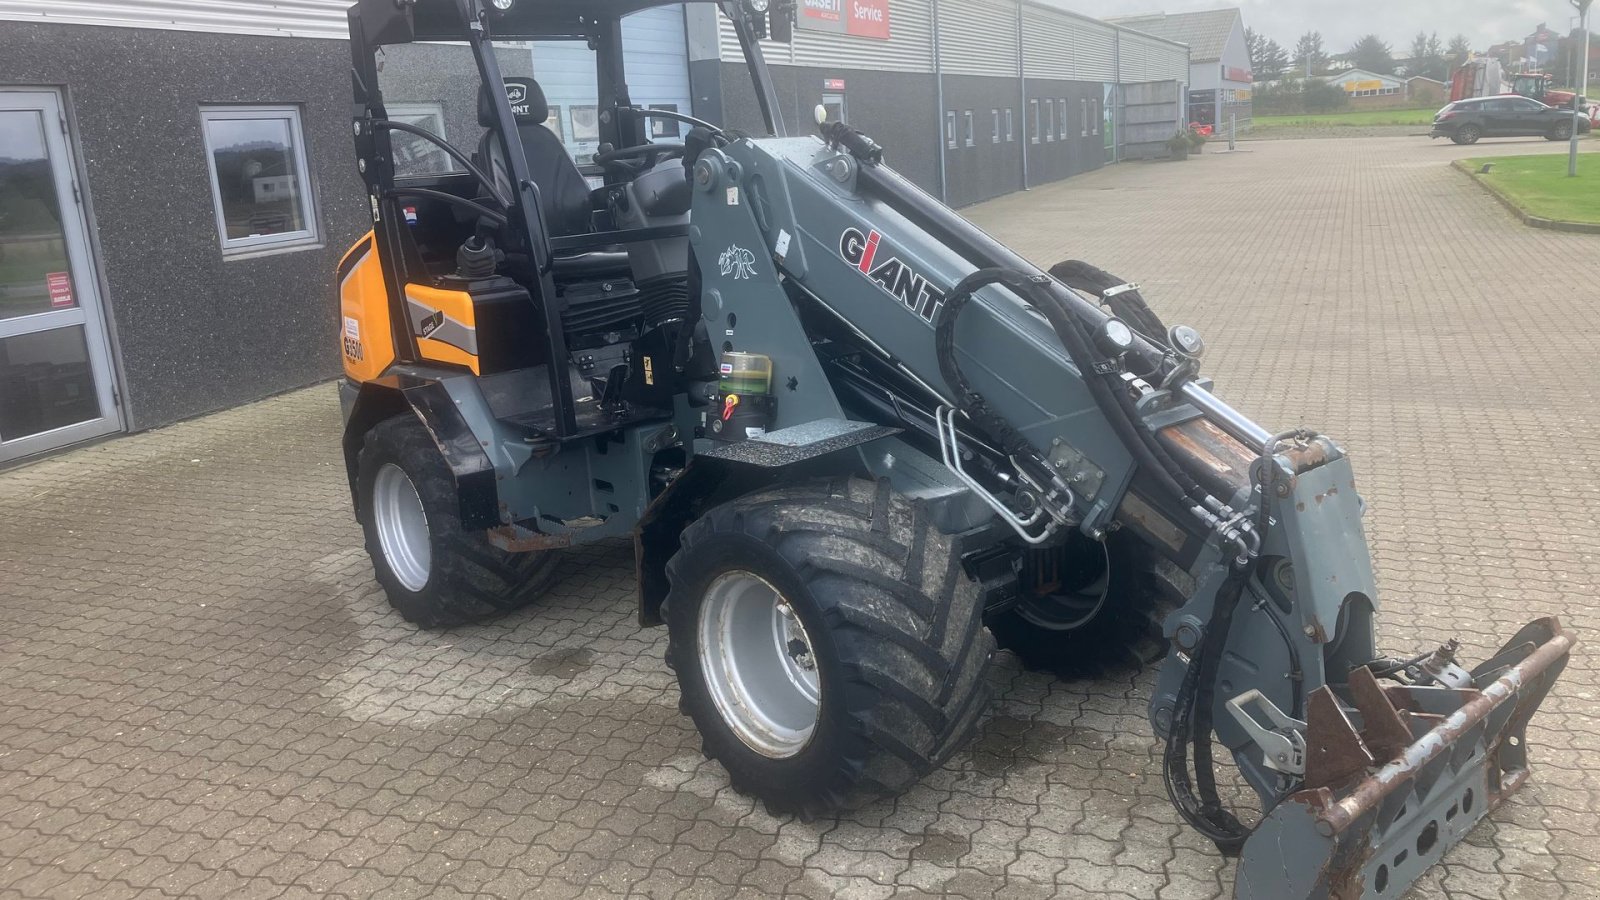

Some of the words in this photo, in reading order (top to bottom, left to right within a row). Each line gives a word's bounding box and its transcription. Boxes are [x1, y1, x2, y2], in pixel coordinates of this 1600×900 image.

[854, 1, 883, 22] Service
[511, 104, 529, 113] ANT
[839, 227, 948, 323] GIANT
[422, 321, 435, 336] STAGE
